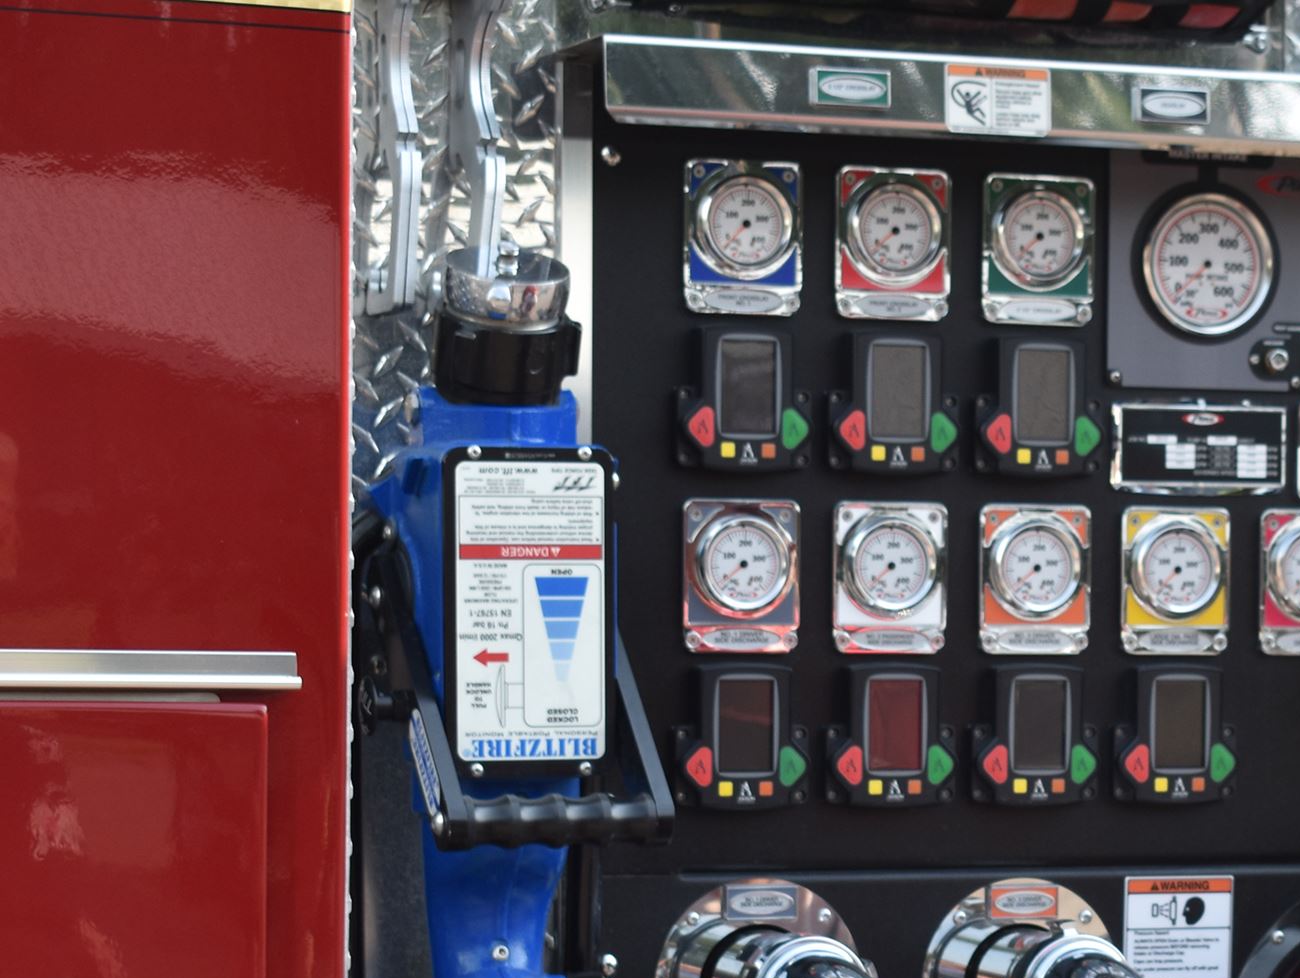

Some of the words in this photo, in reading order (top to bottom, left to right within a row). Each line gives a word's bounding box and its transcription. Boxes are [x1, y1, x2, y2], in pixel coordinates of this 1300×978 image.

[1199, 222, 1218, 234] 300
[1178, 232, 1198, 244] 200
[1218, 238, 1238, 250] 400
[1169, 256, 1188, 267] 100
[1224, 262, 1244, 273] 500
[1213, 286, 1234, 298] 600
[501, 547, 549, 557] DANGER
[551, 568, 573, 576] OPEN
[471, 738, 597, 758] BLITZFIRE
[1161, 880, 1210, 890] WARNING
